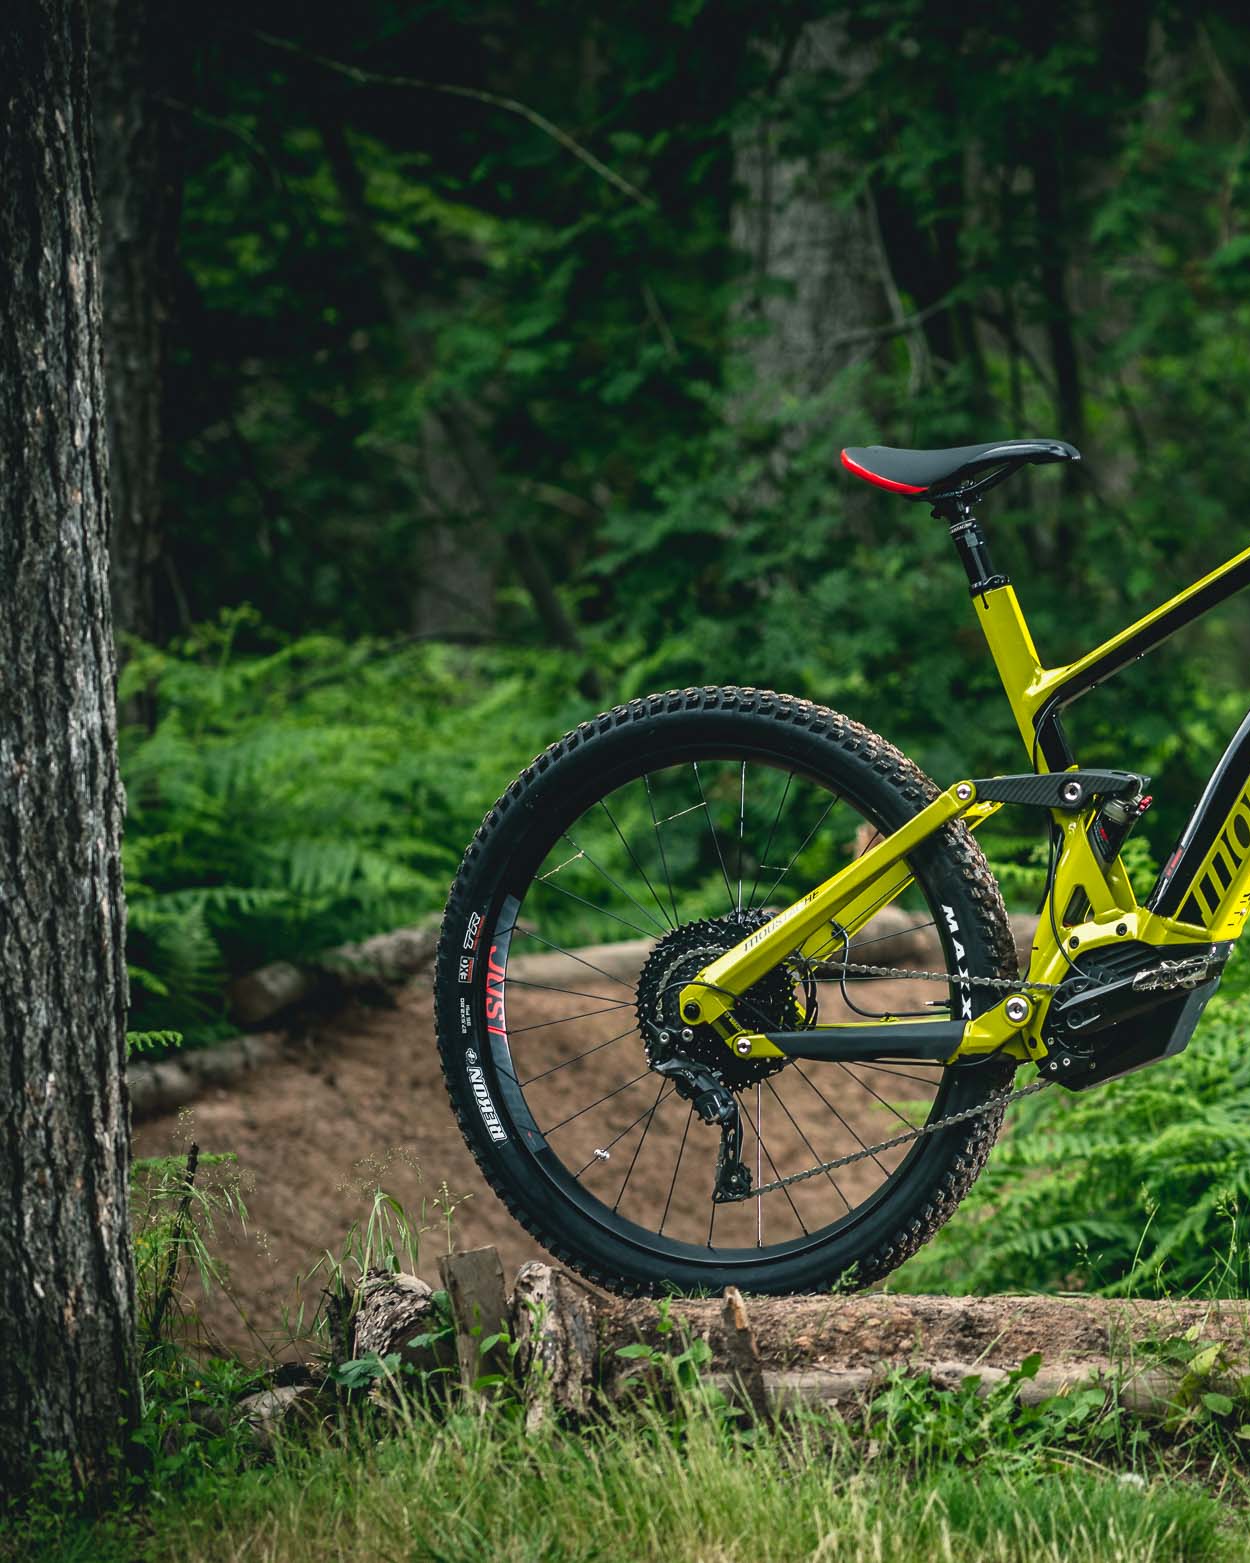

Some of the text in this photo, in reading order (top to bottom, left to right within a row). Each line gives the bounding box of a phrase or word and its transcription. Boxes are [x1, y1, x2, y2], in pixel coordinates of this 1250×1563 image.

[463, 911, 481, 949] TR
[941, 904, 972, 1020] MAXX
[459, 956, 472, 982] EXO
[486, 945, 507, 1037] JUST
